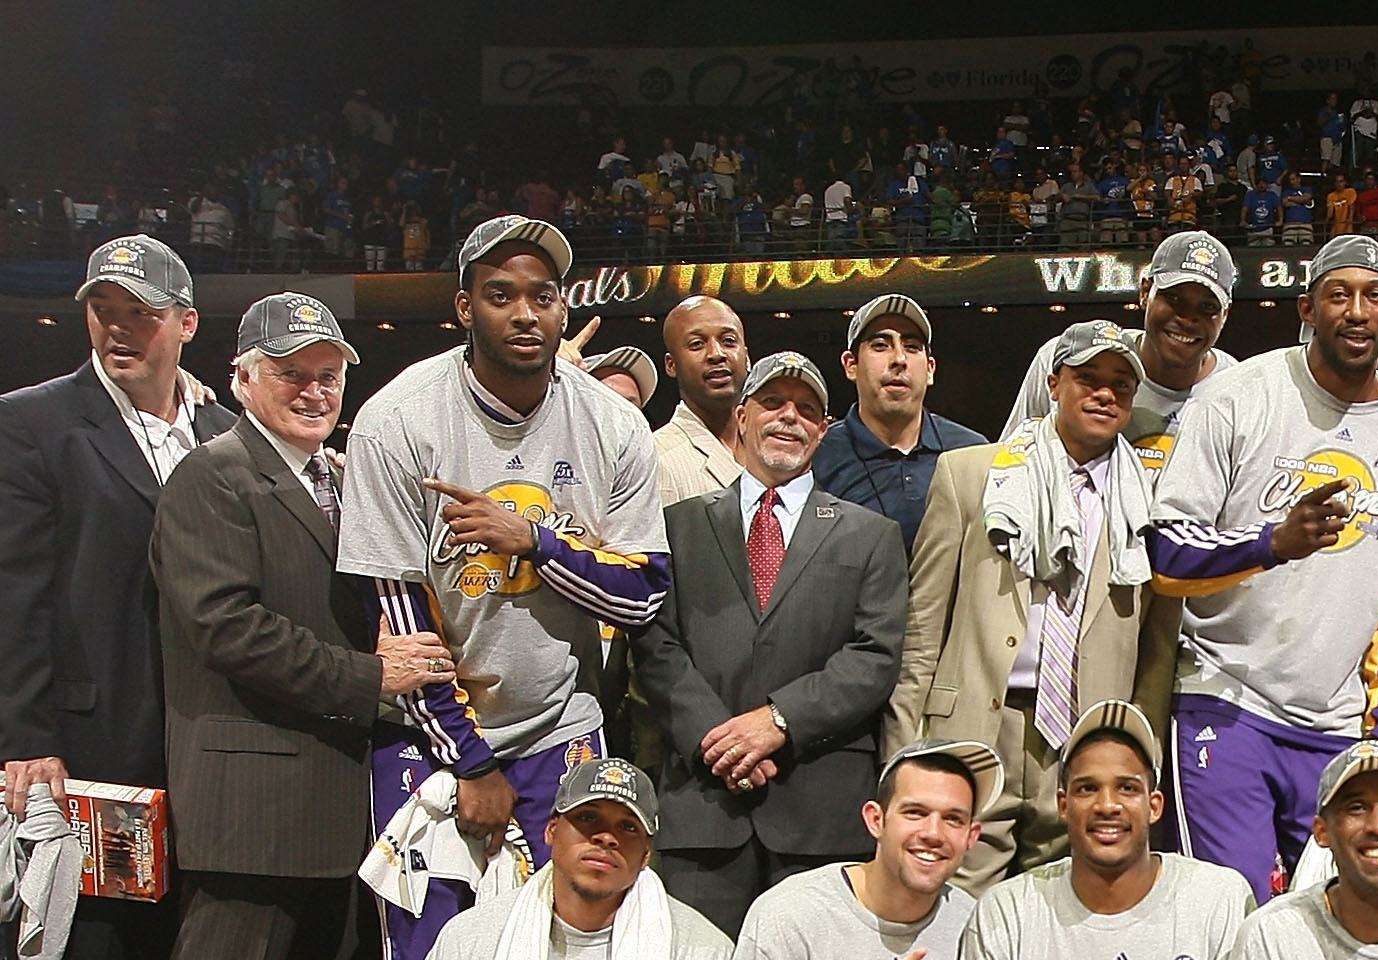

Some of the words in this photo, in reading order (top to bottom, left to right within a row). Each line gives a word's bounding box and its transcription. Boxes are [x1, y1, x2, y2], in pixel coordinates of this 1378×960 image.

[99, 263, 146, 279] CHAMPIONS
[288, 323, 334, 337] CHAMPIONS
[1308, 462, 1338, 476] NBA
[451, 571, 501, 592] LAKERS
[589, 785, 638, 802] CHAMPIONS
